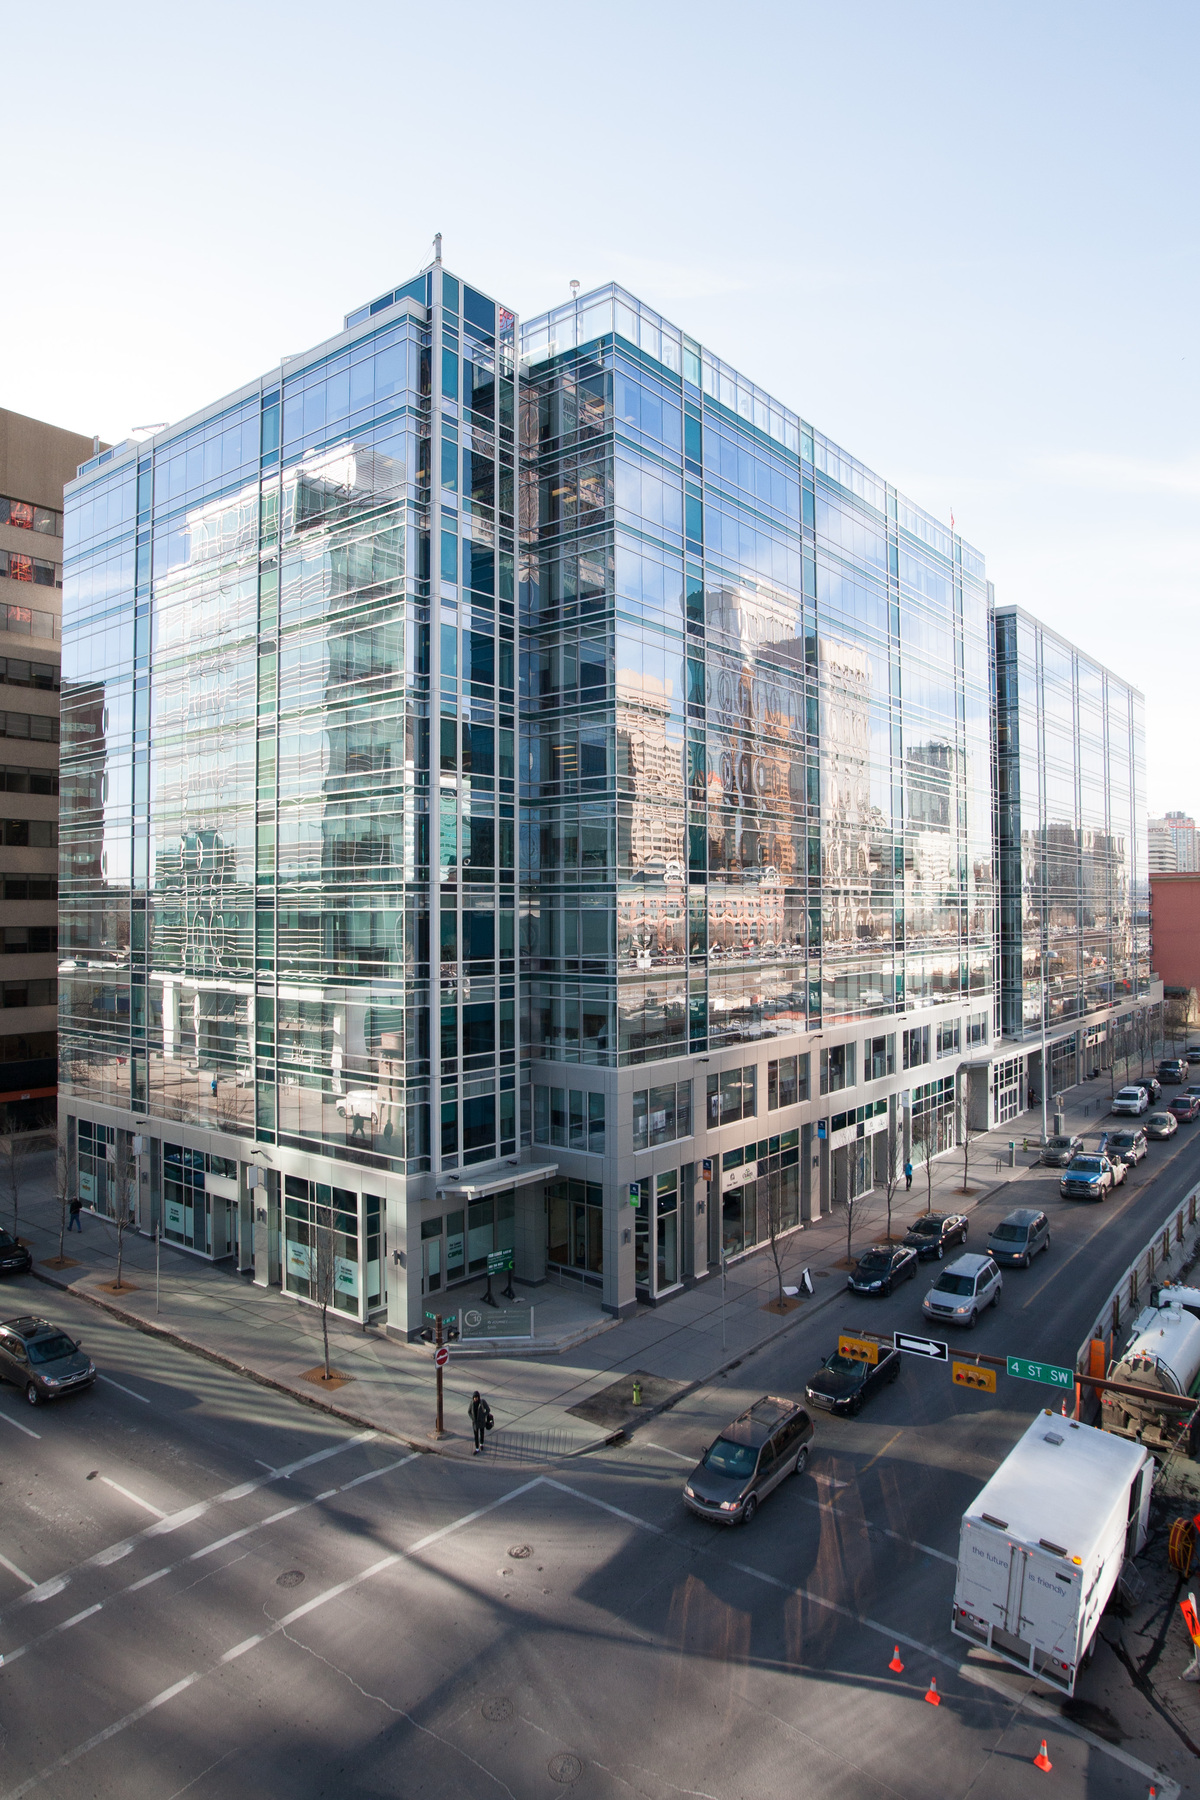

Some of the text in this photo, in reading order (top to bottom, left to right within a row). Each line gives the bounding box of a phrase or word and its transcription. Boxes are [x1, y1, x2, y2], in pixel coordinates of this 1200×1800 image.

[1011, 1362, 1069, 1384] 4 ST SW
[972, 1546, 1067, 1597] the future is friendly
